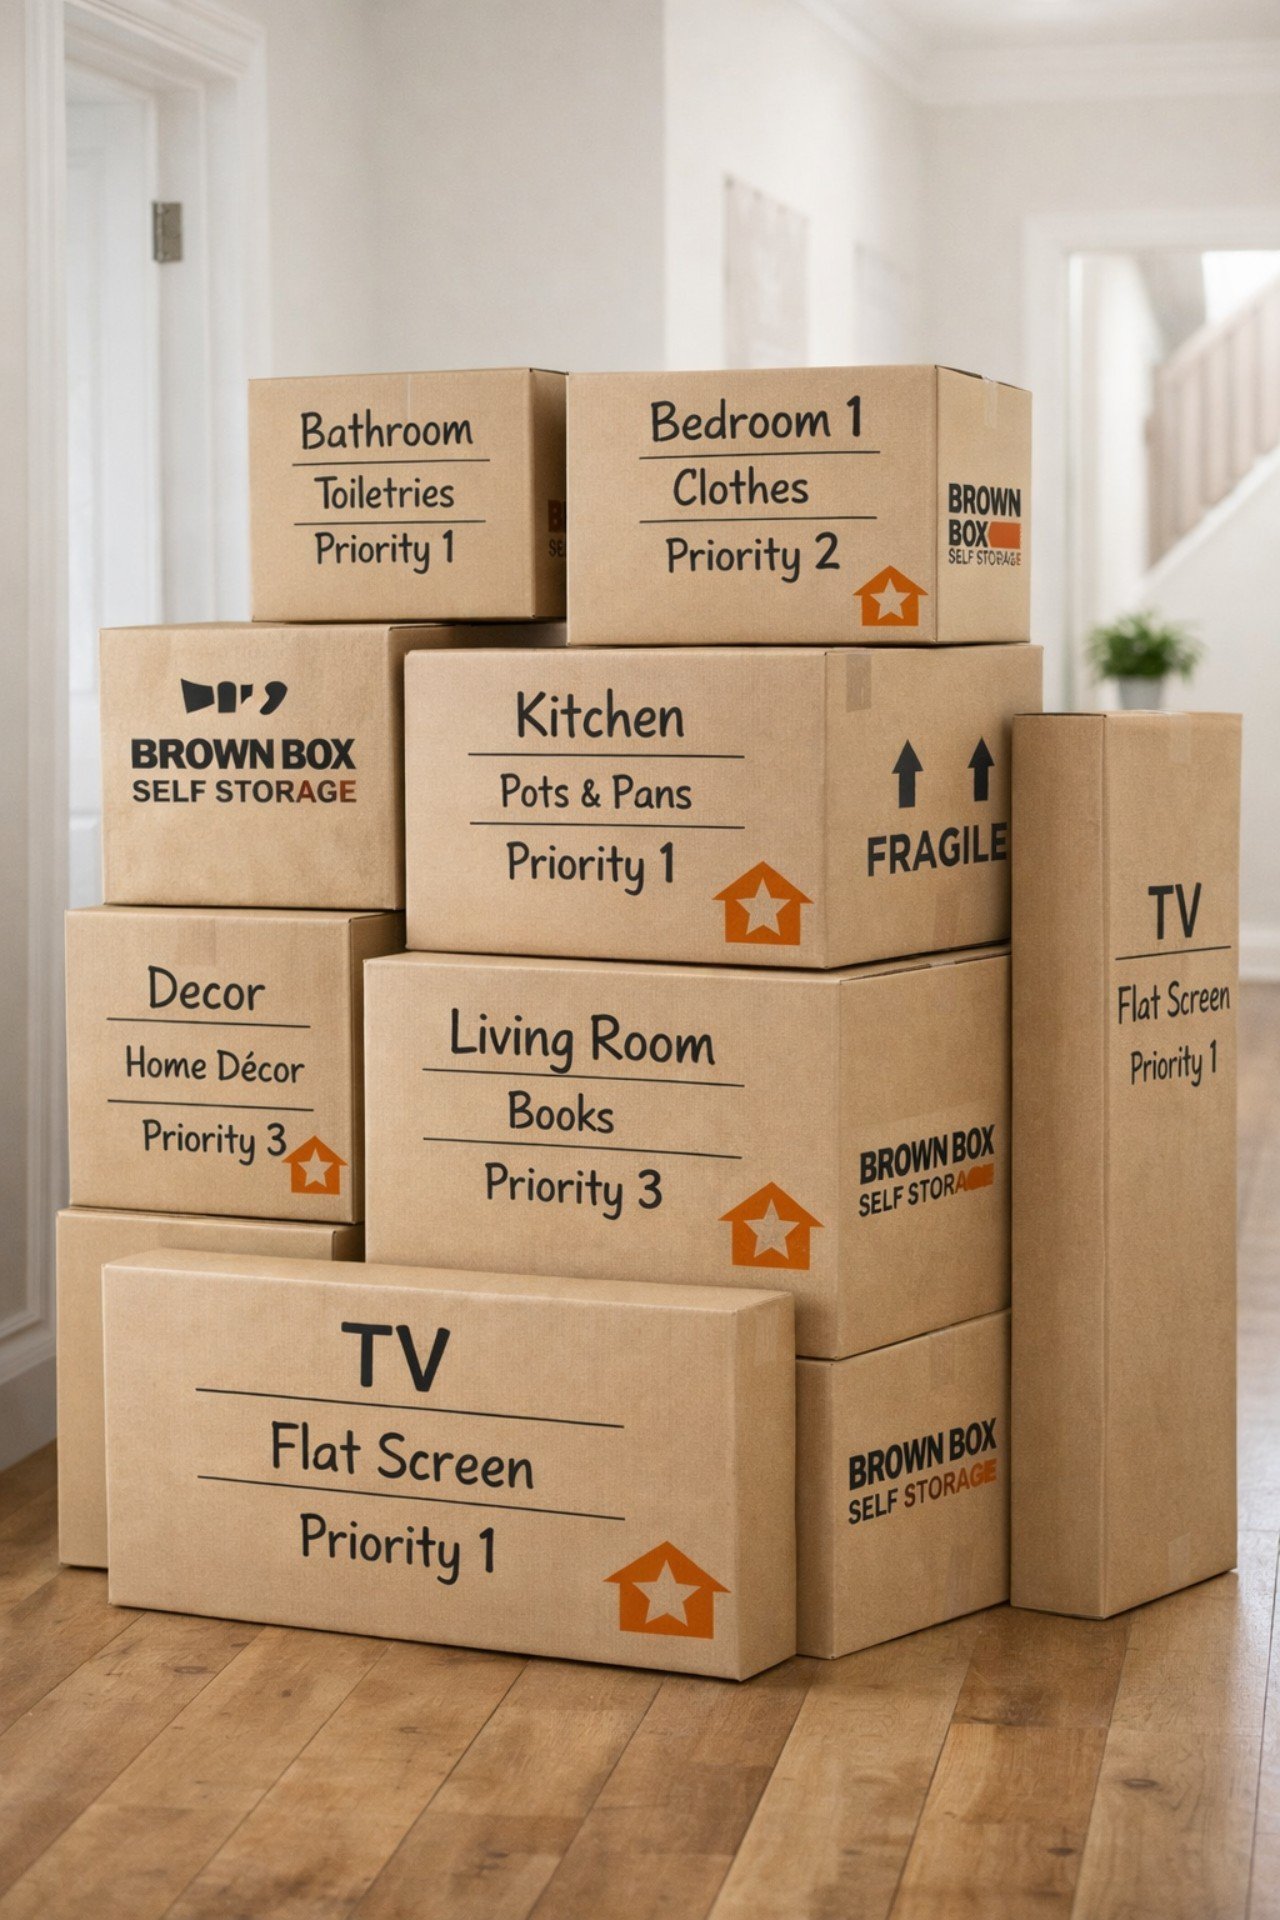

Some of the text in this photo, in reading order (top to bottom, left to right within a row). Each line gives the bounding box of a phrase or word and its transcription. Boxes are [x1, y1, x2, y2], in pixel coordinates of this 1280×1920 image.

[301, 408, 473, 450] Bathroom
[650, 395, 861, 442] Bedroom 1
[314, 474, 455, 509] Toiletries
[673, 465, 809, 506] Clothes
[948, 483, 1021, 518] BROWN
[314, 529, 453, 575] Priority 1
[665, 531, 840, 583] Priority 2
[948, 519, 988, 548] BOX
[948, 548, 974, 565] SELF
[517, 688, 685, 738] Kitchen
[131, 738, 356, 770] BROWN BOX
[132, 779, 357, 803] SELF STORAGE
[500, 773, 692, 810] Pots & Pans
[506, 841, 673, 896] Priority 1
[867, 822, 1008, 877] FRAGILE
[1147, 882, 1202, 940] TV
[148, 965, 266, 1011] Decor
[1118, 980, 1230, 1025] Flat Screen
[126, 1045, 305, 1083] Home Décor
[450, 1008, 716, 1074] Living Room
[1130, 1039, 1217, 1087] Priority 1
[508, 1090, 614, 1134] Books
[142, 1119, 287, 1166] Priority 3
[860, 1124, 995, 1185] BROWN BOX
[484, 1162, 662, 1221] Priority 3
[859, 1163, 994, 1217] SELF STORA
[341, 1321, 450, 1392] TV
[271, 1420, 534, 1490] Flat Screen
[849, 1418, 997, 1491] BROWN BOX
[848, 1458, 997, 1525] SELF STORAGE
[300, 1513, 494, 1586] Priority 1
